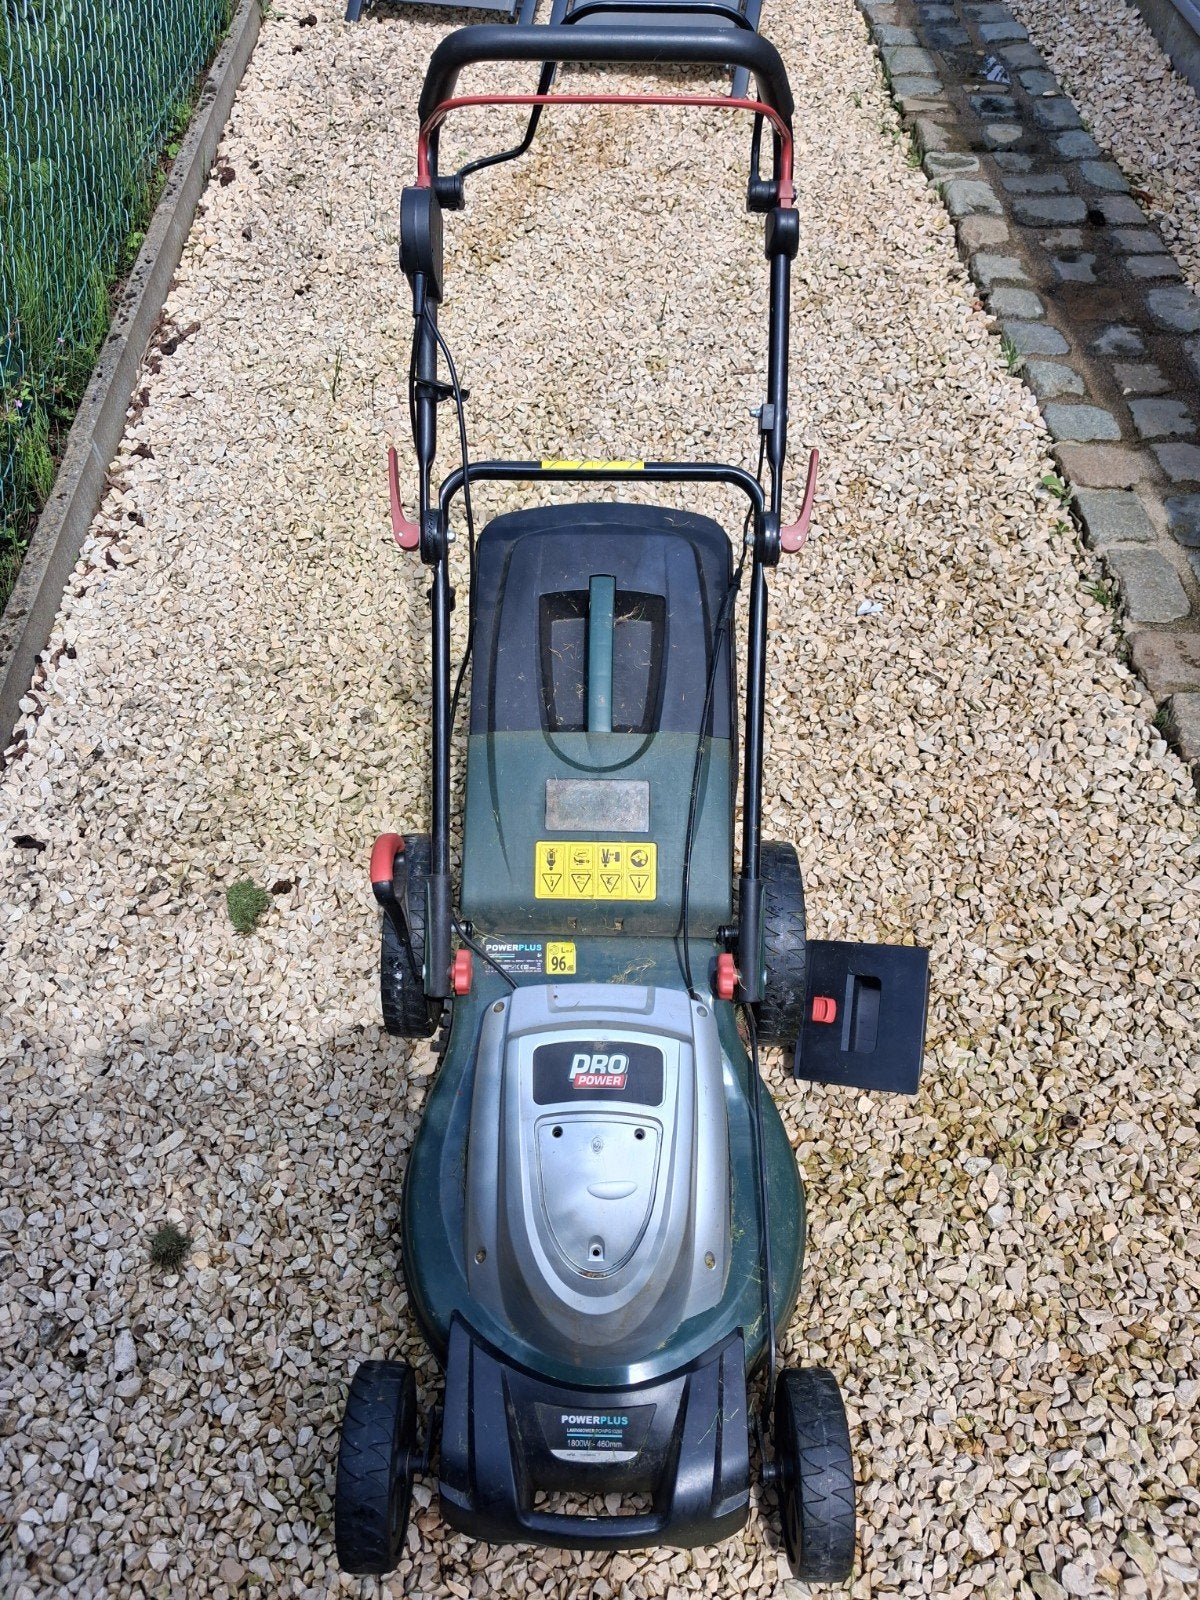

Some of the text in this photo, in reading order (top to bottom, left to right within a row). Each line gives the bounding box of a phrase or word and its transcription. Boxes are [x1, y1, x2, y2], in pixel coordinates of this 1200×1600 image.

[551, 956, 566, 971] 96
[569, 1054, 627, 1079] PRO
[578, 1076, 621, 1085] POWER
[561, 1415, 628, 1425] POWERPLUS
[567, 1439, 590, 1447] 1800W
